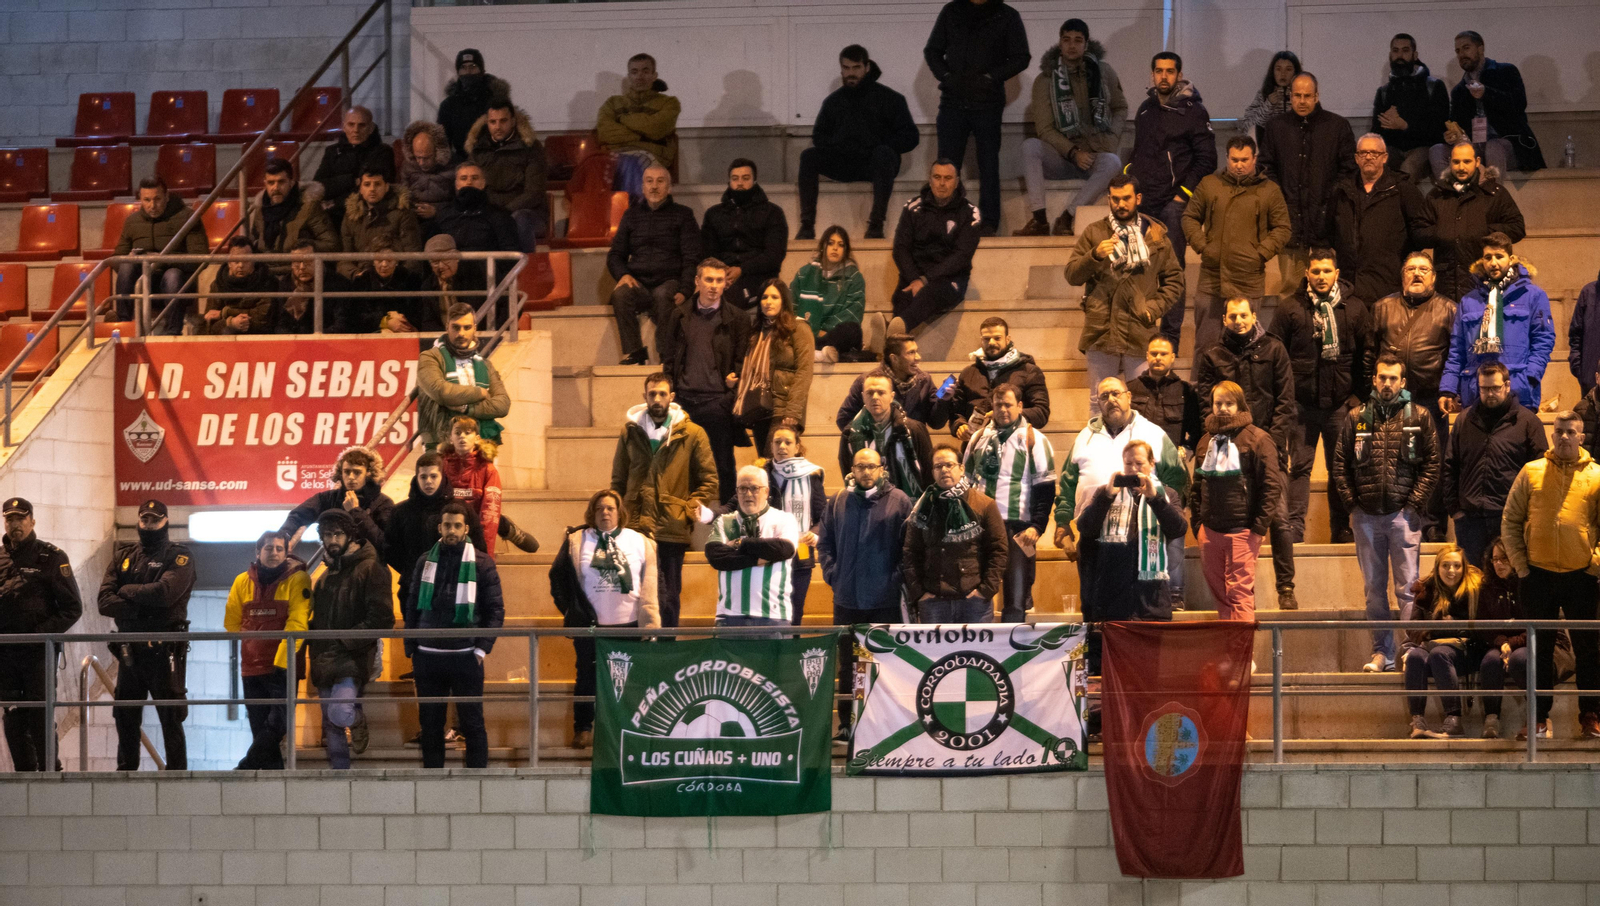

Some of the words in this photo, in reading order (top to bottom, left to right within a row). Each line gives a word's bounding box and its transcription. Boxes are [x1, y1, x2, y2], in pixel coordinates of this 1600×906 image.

[124, 362, 190, 400] U.D.
[203, 361, 277, 399] SAN
[197, 413, 238, 446] DE
[245, 412, 305, 446] LOS
[301, 469, 317, 479] San
[120, 479, 248, 491] www.ud-sanse.com
[300, 479, 313, 489] de
[313, 479, 325, 489] los
[631, 681, 670, 729] PEÑA
[674, 660, 800, 729] CORDOBESISTA
[935, 728, 996, 748] 2001
[641, 751, 670, 766] LOS
[674, 747, 733, 766] CUÑAOS
[751, 751, 782, 766] UNO
[851, 748, 935, 773] Siempre
[943, 758, 957, 768] a
[963, 753, 986, 768] tu
[992, 748, 1038, 766] lado
[676, 780, 742, 793] CÓRDOBA
